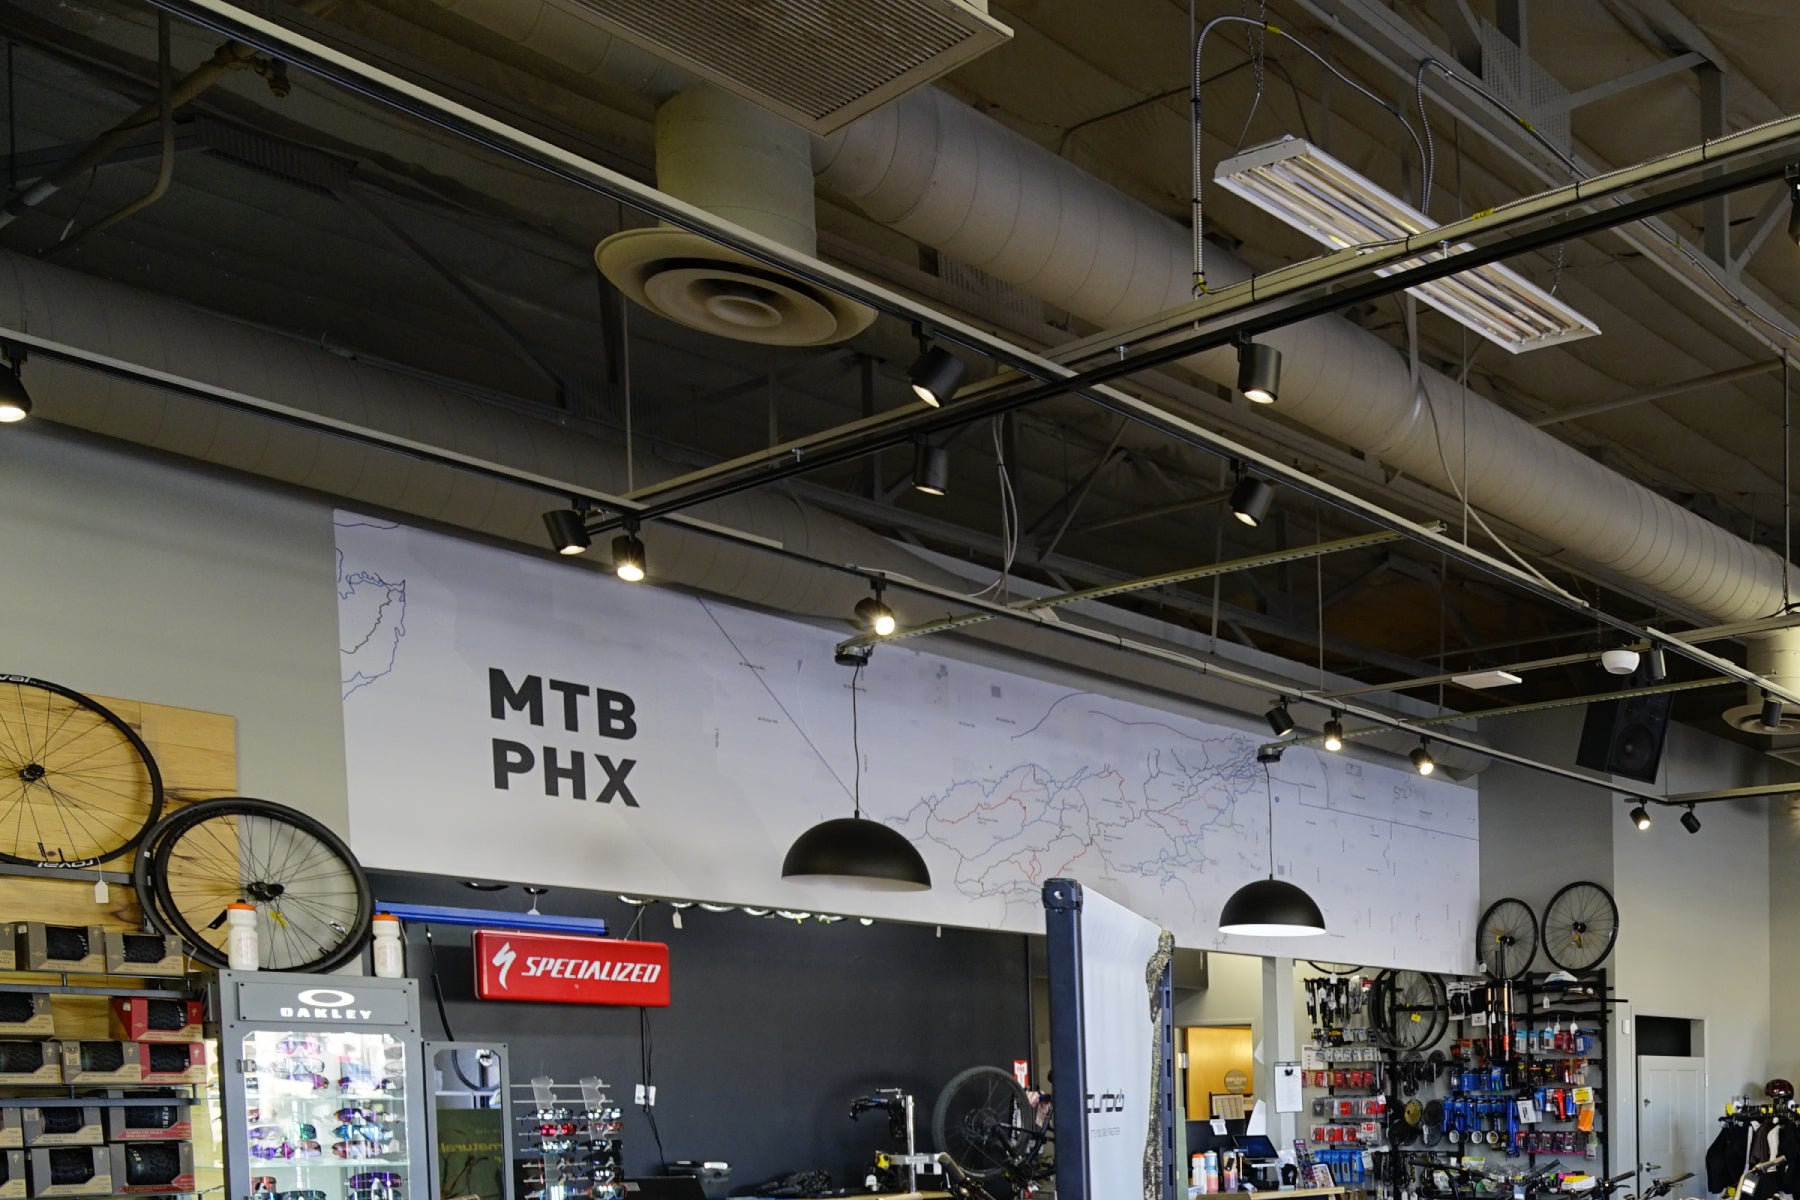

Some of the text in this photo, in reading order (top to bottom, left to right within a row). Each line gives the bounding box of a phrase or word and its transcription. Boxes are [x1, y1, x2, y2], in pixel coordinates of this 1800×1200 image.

[488, 667, 638, 740] MTB
[492, 737, 640, 808] PHX
[37, 859, 93, 868] roval
[521, 956, 661, 984] SPECIALIZED
[280, 1007, 372, 1020] OAKLEY
